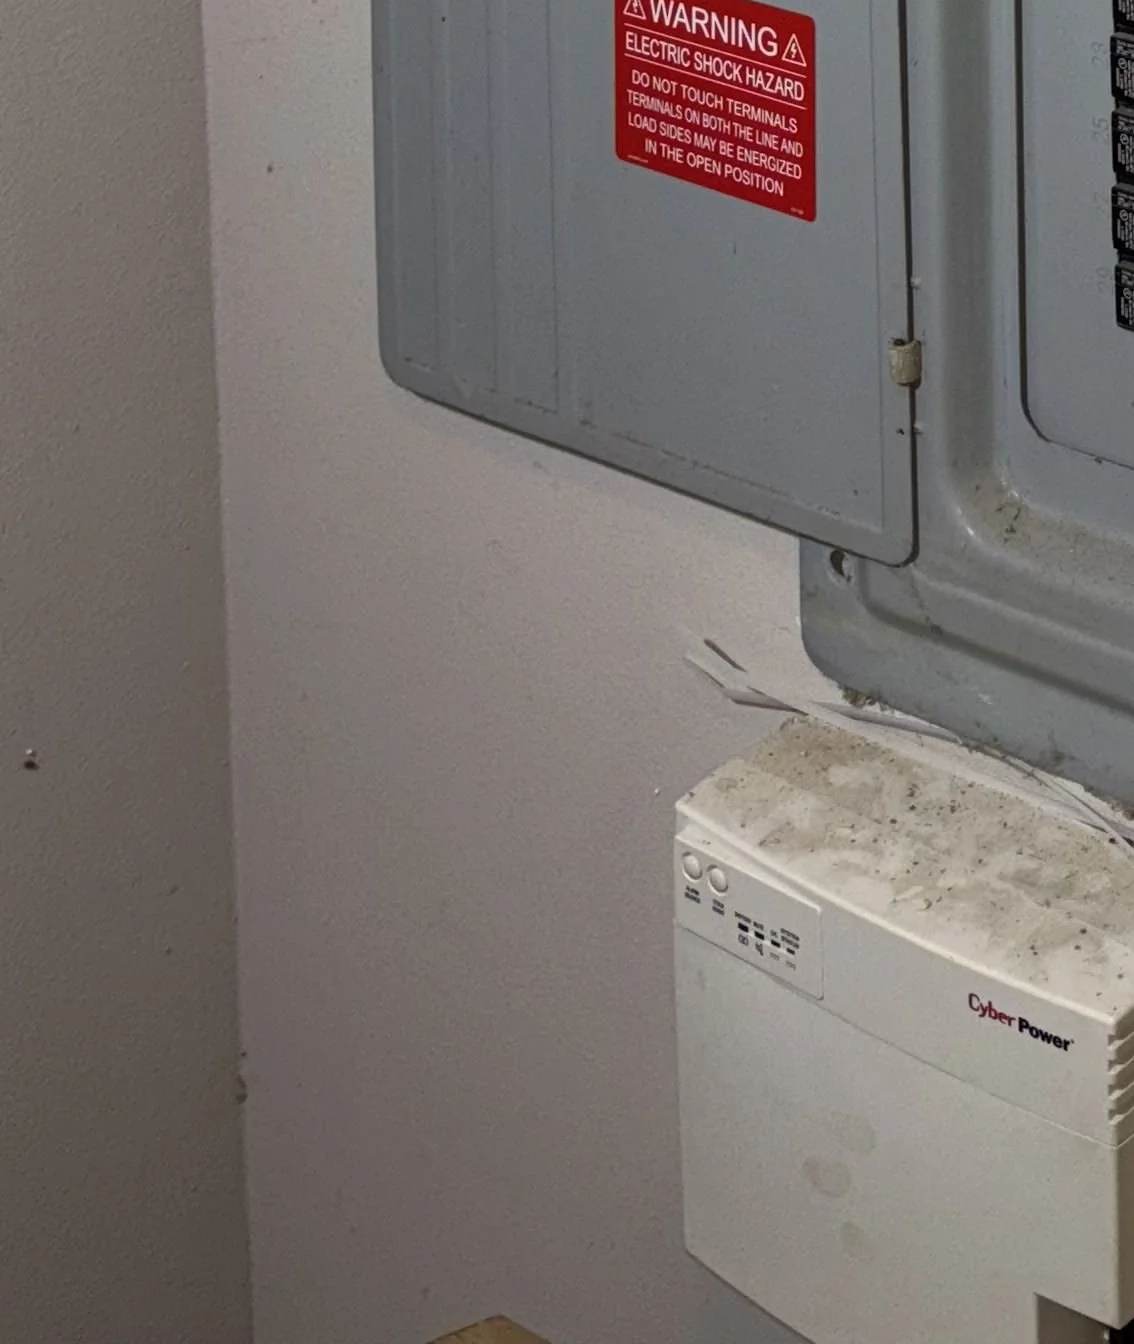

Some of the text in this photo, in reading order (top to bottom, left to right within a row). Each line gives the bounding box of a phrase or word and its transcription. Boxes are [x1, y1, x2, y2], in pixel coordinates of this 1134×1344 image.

[625, 30, 805, 102] ELECTRIC SHOCK HAZARD
[626, 89, 804, 159] TERMINALS ON BOTH THE LINE AND
[632, 69, 798, 134] DO NOT TOUCH TERMINALS
[628, 111, 803, 180] LOAD SIDES MAY BE ENERGIZED
[645, 138, 658, 156] IN
[660, 142, 684, 163] THE
[686, 151, 722, 177] OPEN
[724, 162, 784, 197] POSITION
